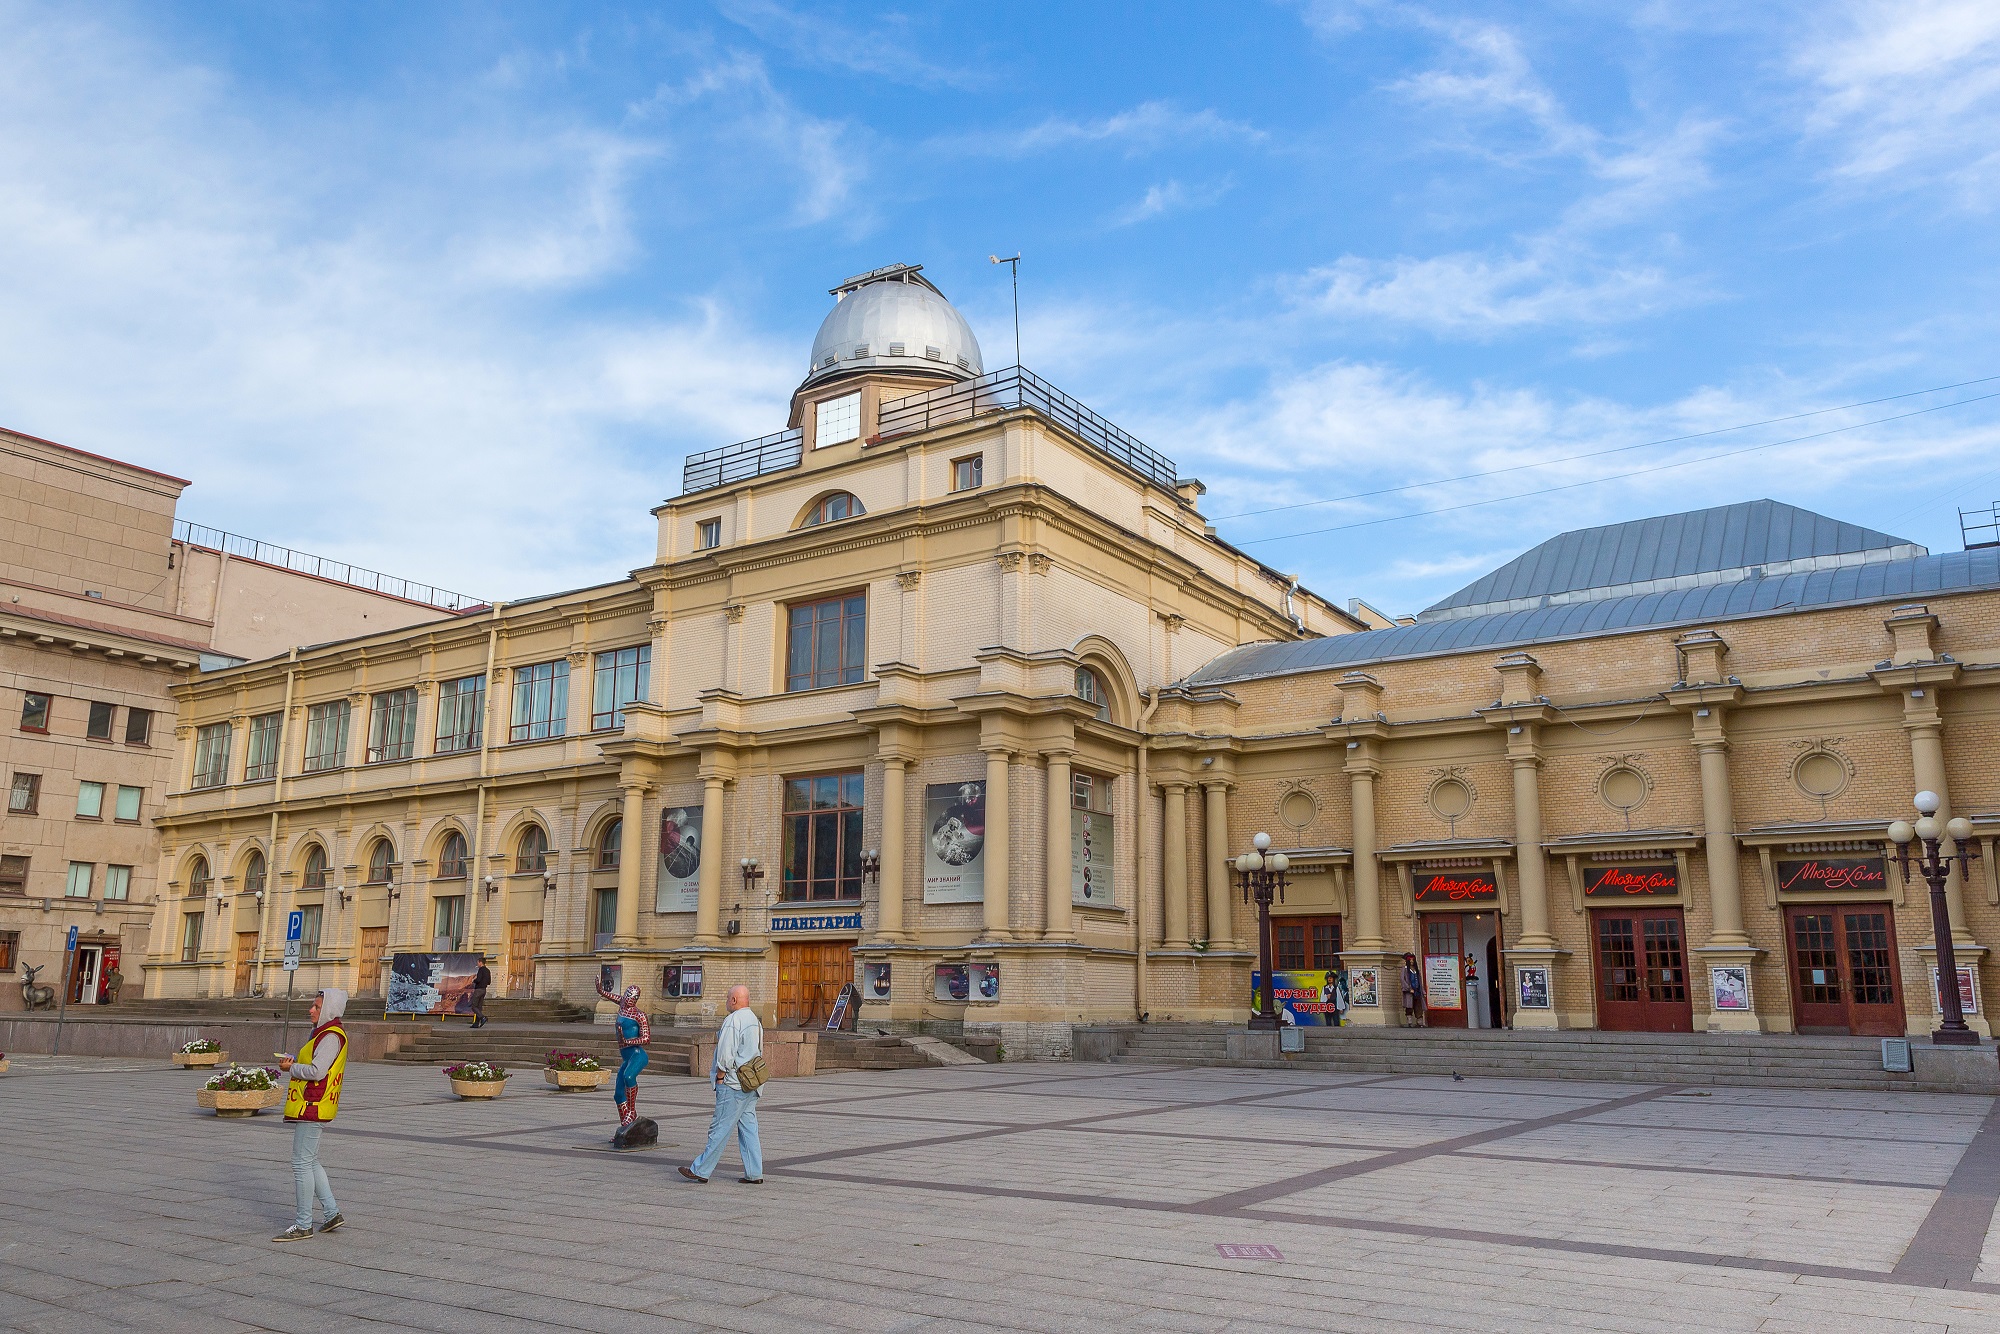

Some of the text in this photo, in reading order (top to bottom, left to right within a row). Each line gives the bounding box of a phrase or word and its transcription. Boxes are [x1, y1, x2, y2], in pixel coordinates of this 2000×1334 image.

[290, 914, 300, 938] P
[771, 912, 862, 931] ПЛАНЕТАРИЙ
[1274, 986, 1317, 999] МУЗЕЙ
[1292, 1003, 1335, 1014] ЧУДЕС
